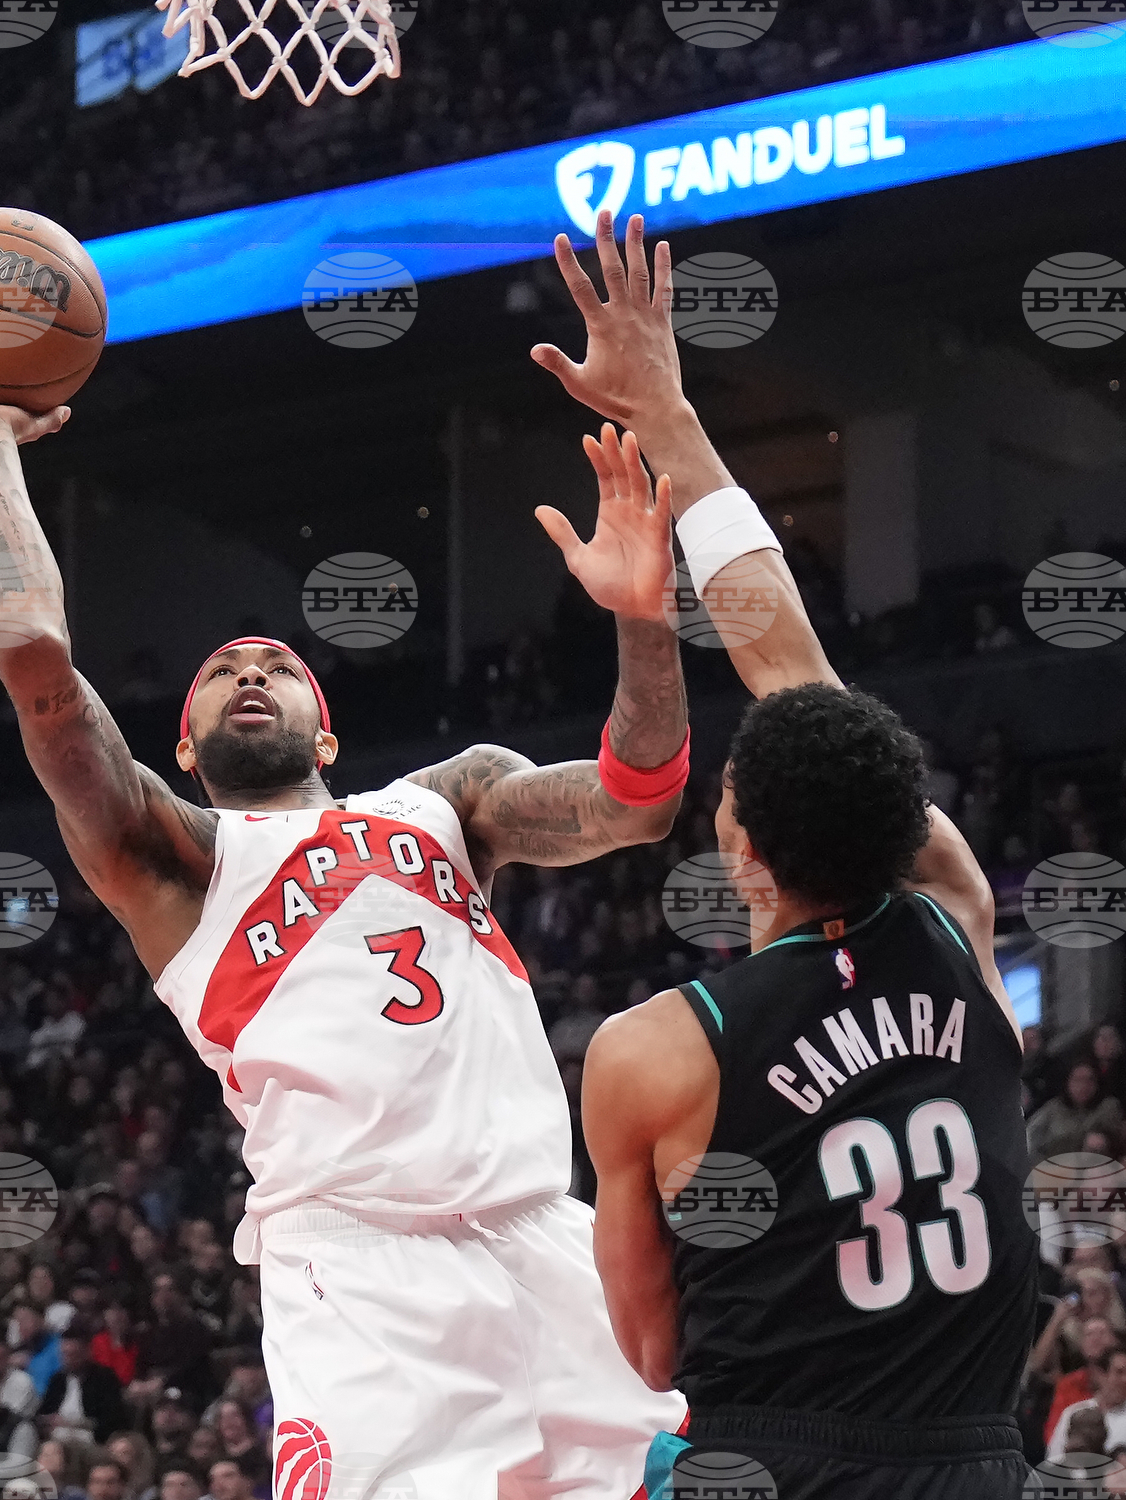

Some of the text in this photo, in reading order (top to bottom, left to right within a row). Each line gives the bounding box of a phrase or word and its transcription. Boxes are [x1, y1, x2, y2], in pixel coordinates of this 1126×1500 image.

[644, 103, 906, 206] FANDUEL
[245, 819, 494, 966] RAPTORS
[363, 925, 445, 1026] 3
[766, 992, 968, 1116] CAMARA
[817, 1096, 992, 1312] 33
